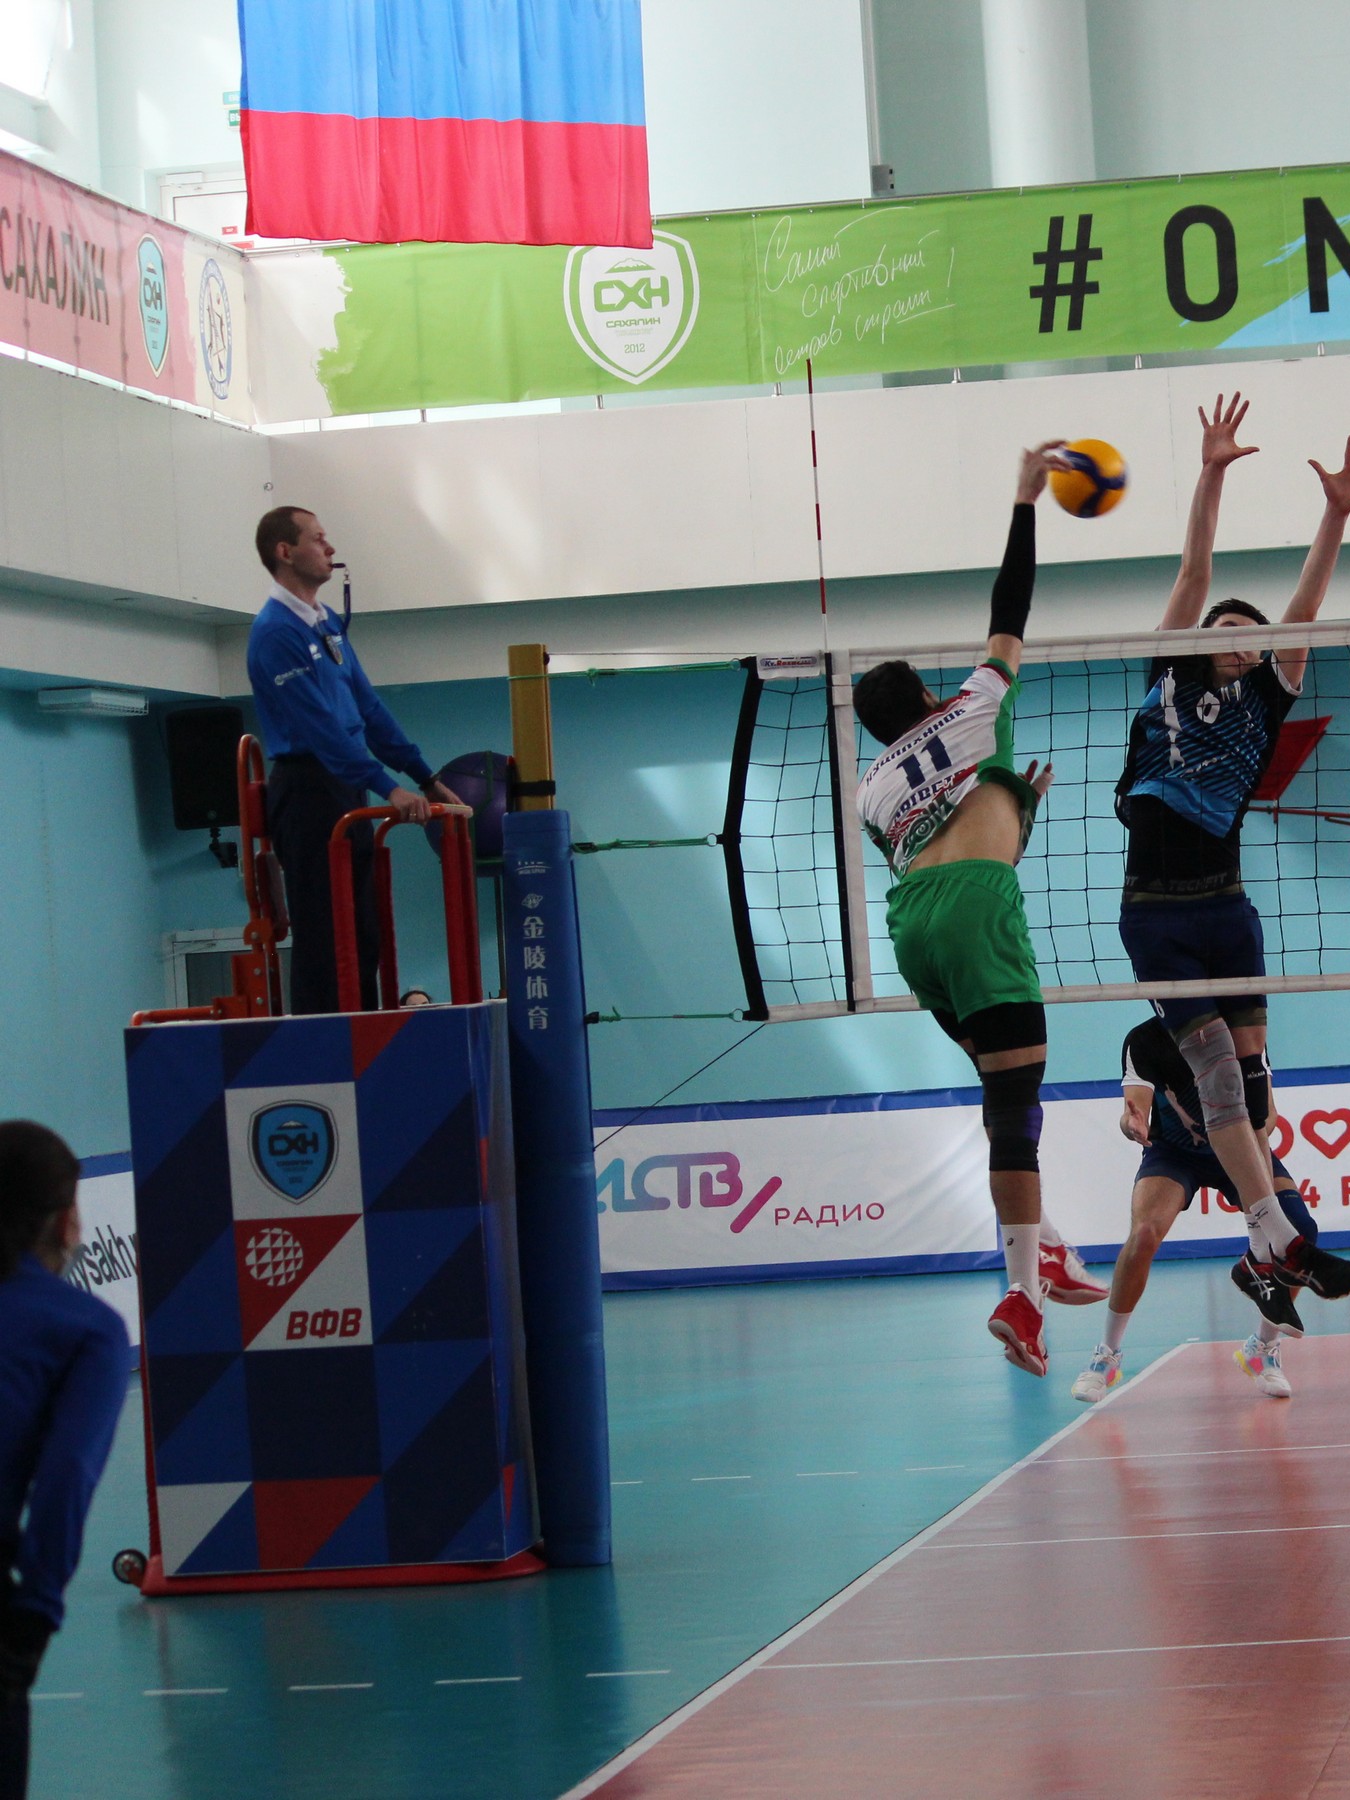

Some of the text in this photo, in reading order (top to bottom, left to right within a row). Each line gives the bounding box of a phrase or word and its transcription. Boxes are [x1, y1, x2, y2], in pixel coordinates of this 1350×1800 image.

[0, 206, 110, 326] САХАЛИН
[606, 317, 661, 329] САХАЛИН
[624, 343, 646, 354] 2012
[896, 735, 952, 790] 11
[522, 915, 549, 1031] 金陵体育
[774, 1202, 885, 1228] РАДИО
[285, 1307, 363, 1341] ВФВ
